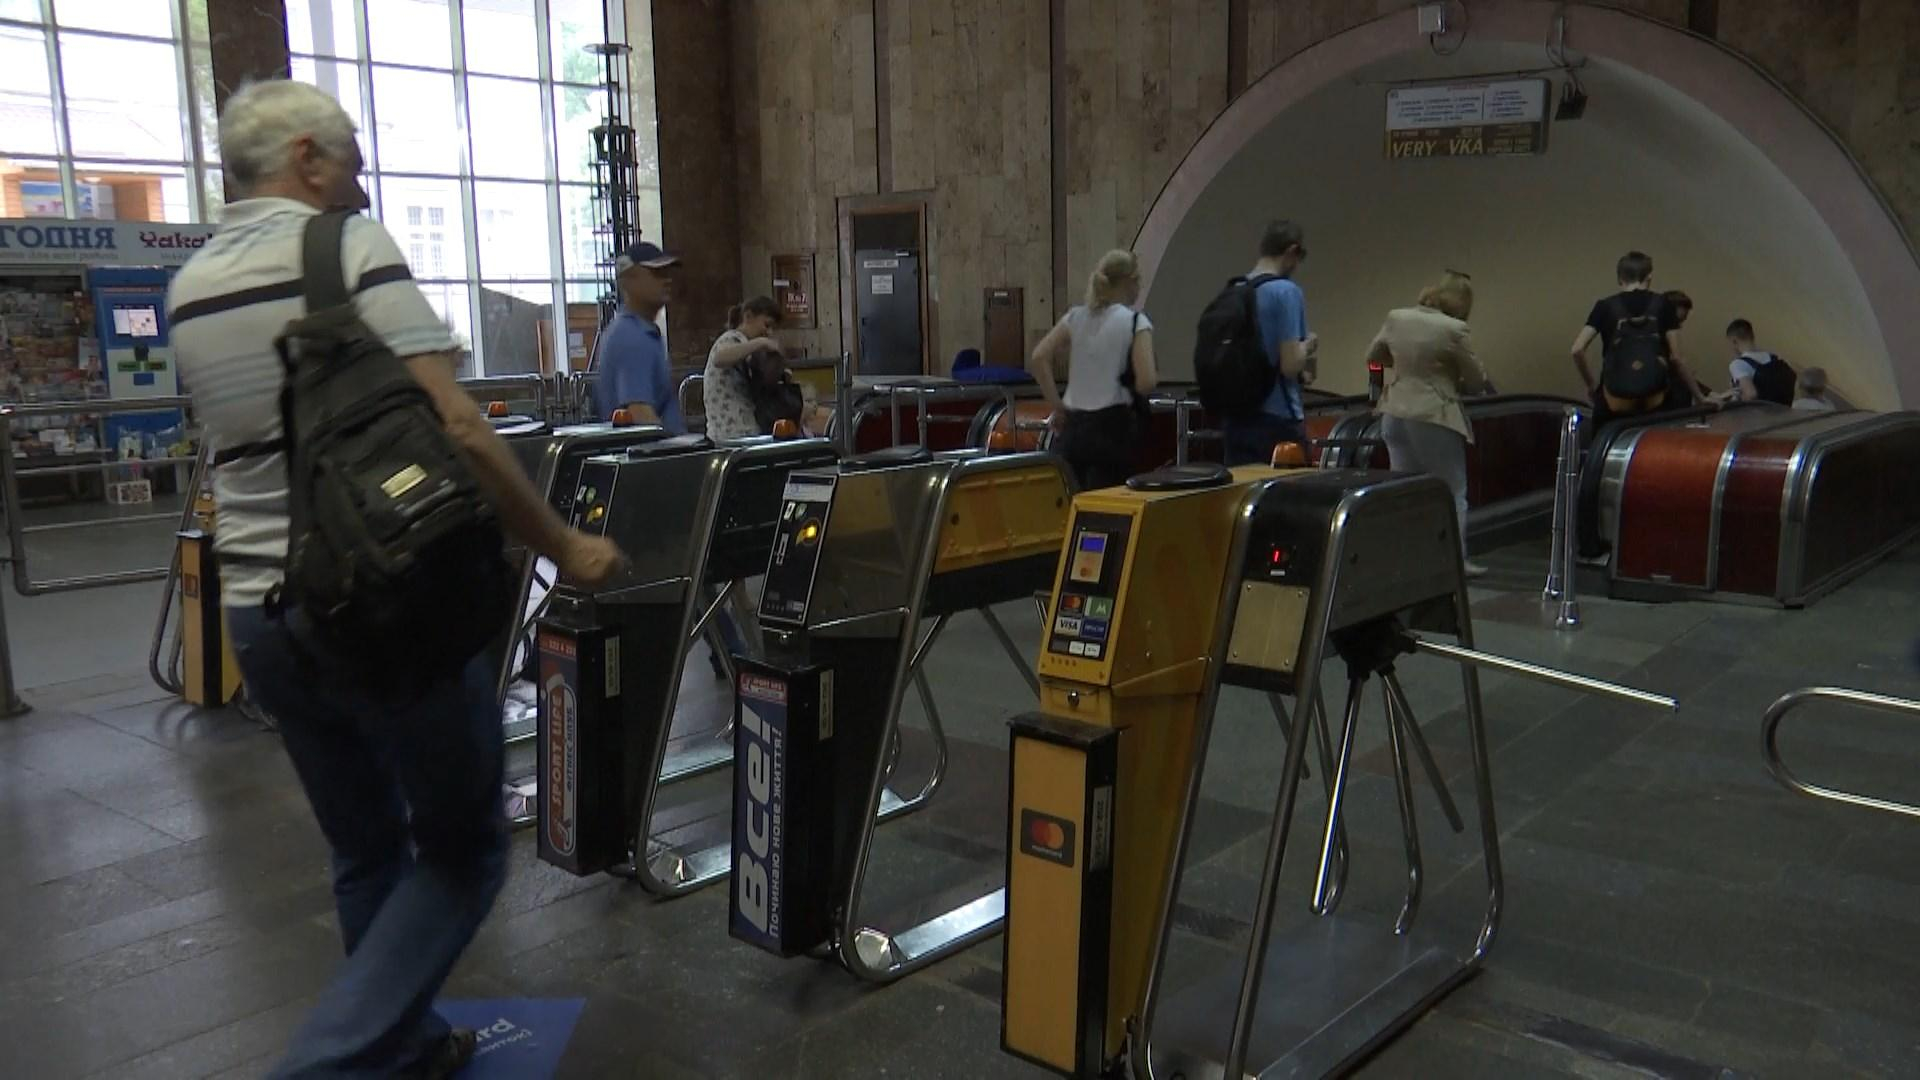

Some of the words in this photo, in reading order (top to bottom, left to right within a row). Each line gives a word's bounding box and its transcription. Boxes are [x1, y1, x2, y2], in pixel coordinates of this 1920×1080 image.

[1060, 618, 1078, 630] VISA
[551, 694, 562, 736] LIFE
[551, 743, 562, 807] SPORT
[739, 703, 771, 934] Все!
